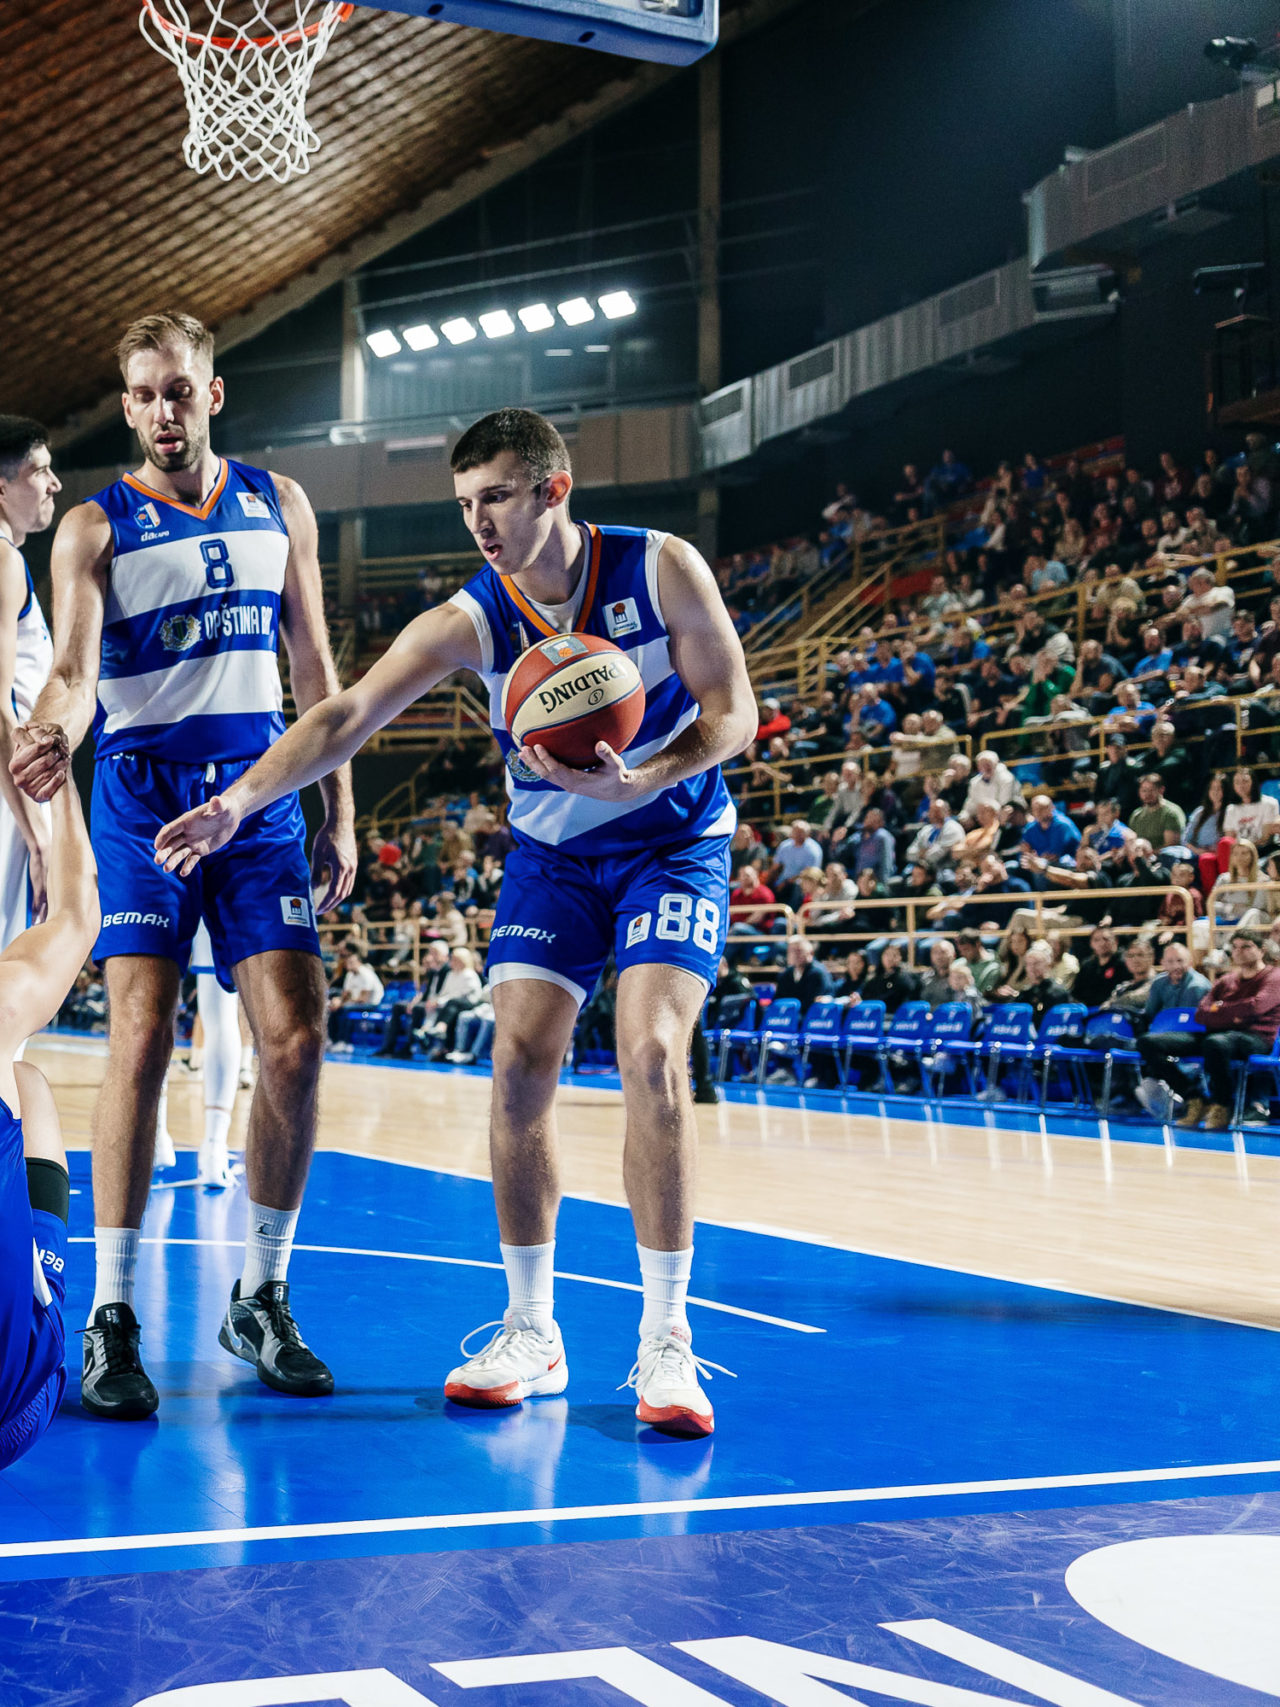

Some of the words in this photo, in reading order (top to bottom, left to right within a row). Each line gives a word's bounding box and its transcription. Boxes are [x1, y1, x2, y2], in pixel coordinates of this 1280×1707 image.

[199, 538, 234, 589] 8
[204, 603, 260, 640] OPŠTINA
[538, 664, 628, 714] PALDING
[102, 911, 170, 928] BEMAX
[655, 893, 721, 955] 88
